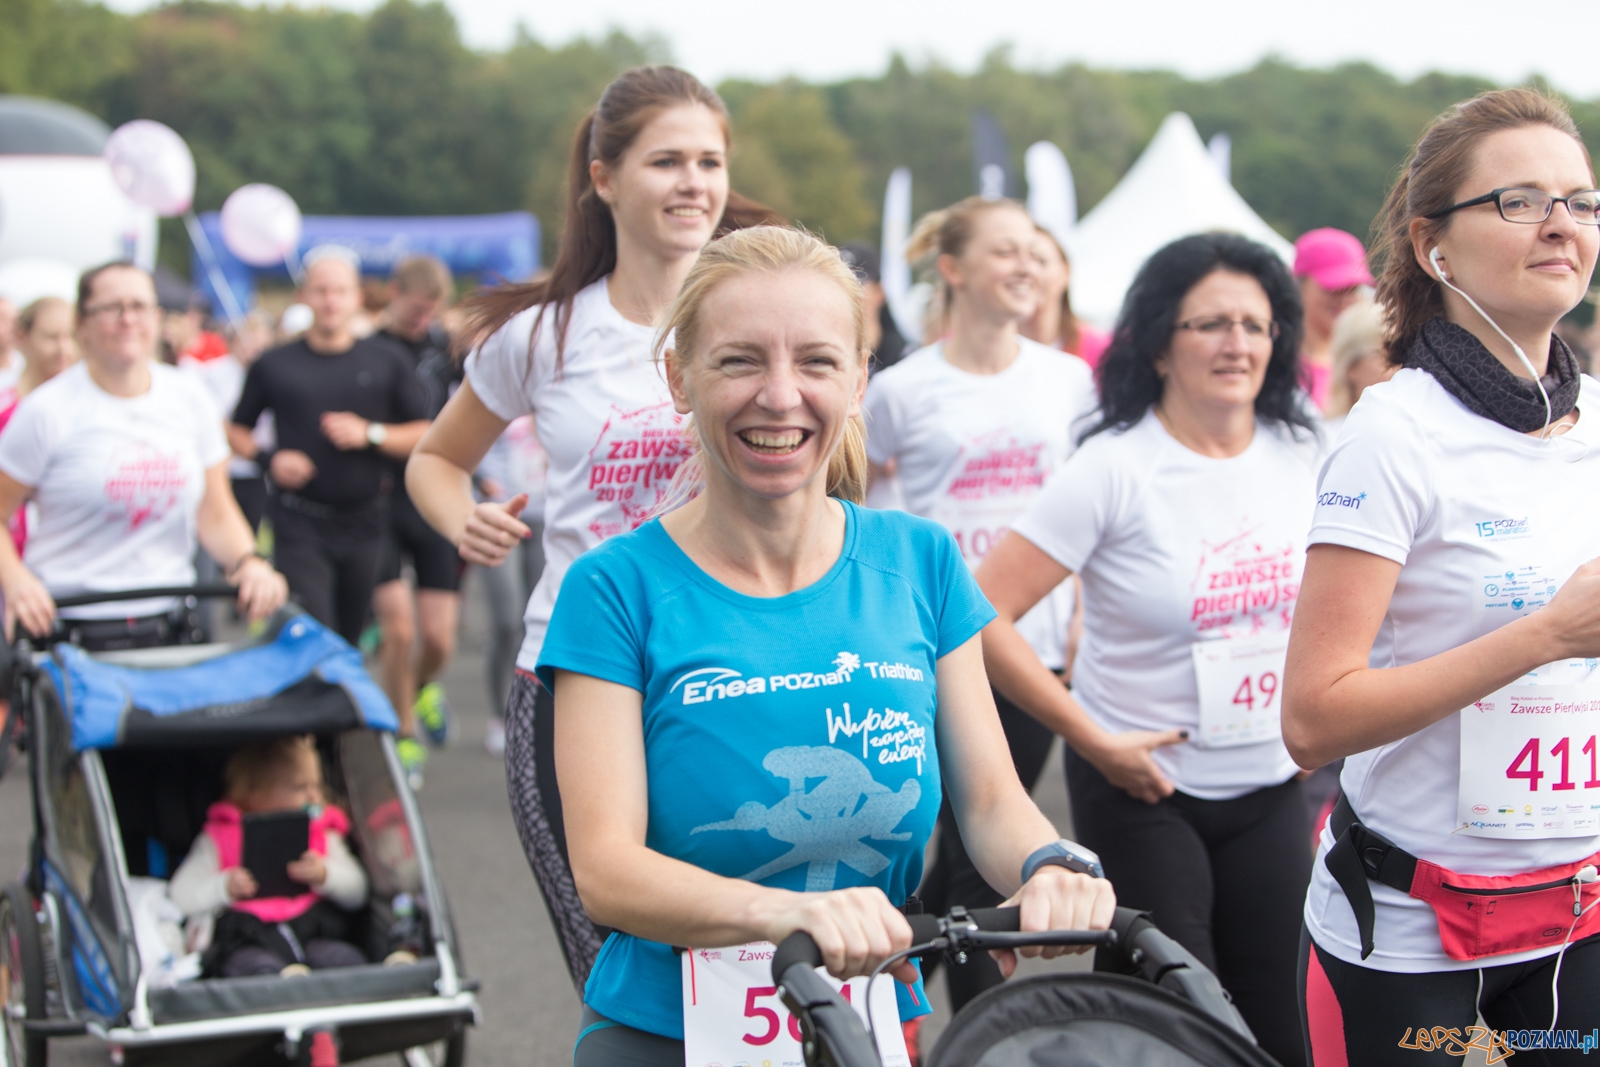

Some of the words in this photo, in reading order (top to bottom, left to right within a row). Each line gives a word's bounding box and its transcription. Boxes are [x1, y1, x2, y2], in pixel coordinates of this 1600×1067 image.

[607, 437, 692, 460] zawsz
[1475, 521, 1495, 537] 15
[1208, 561, 1293, 590] zawsze
[682, 677, 766, 705] Enea
[863, 661, 925, 682] Triathlon
[1232, 671, 1279, 711] 49
[1510, 702, 1552, 714] Zawsze
[1554, 701, 1589, 715] Pier(w)si
[1506, 735, 1600, 791] 411
[1470, 821, 1507, 829] AQUANET
[738, 948, 777, 963] Zaws
